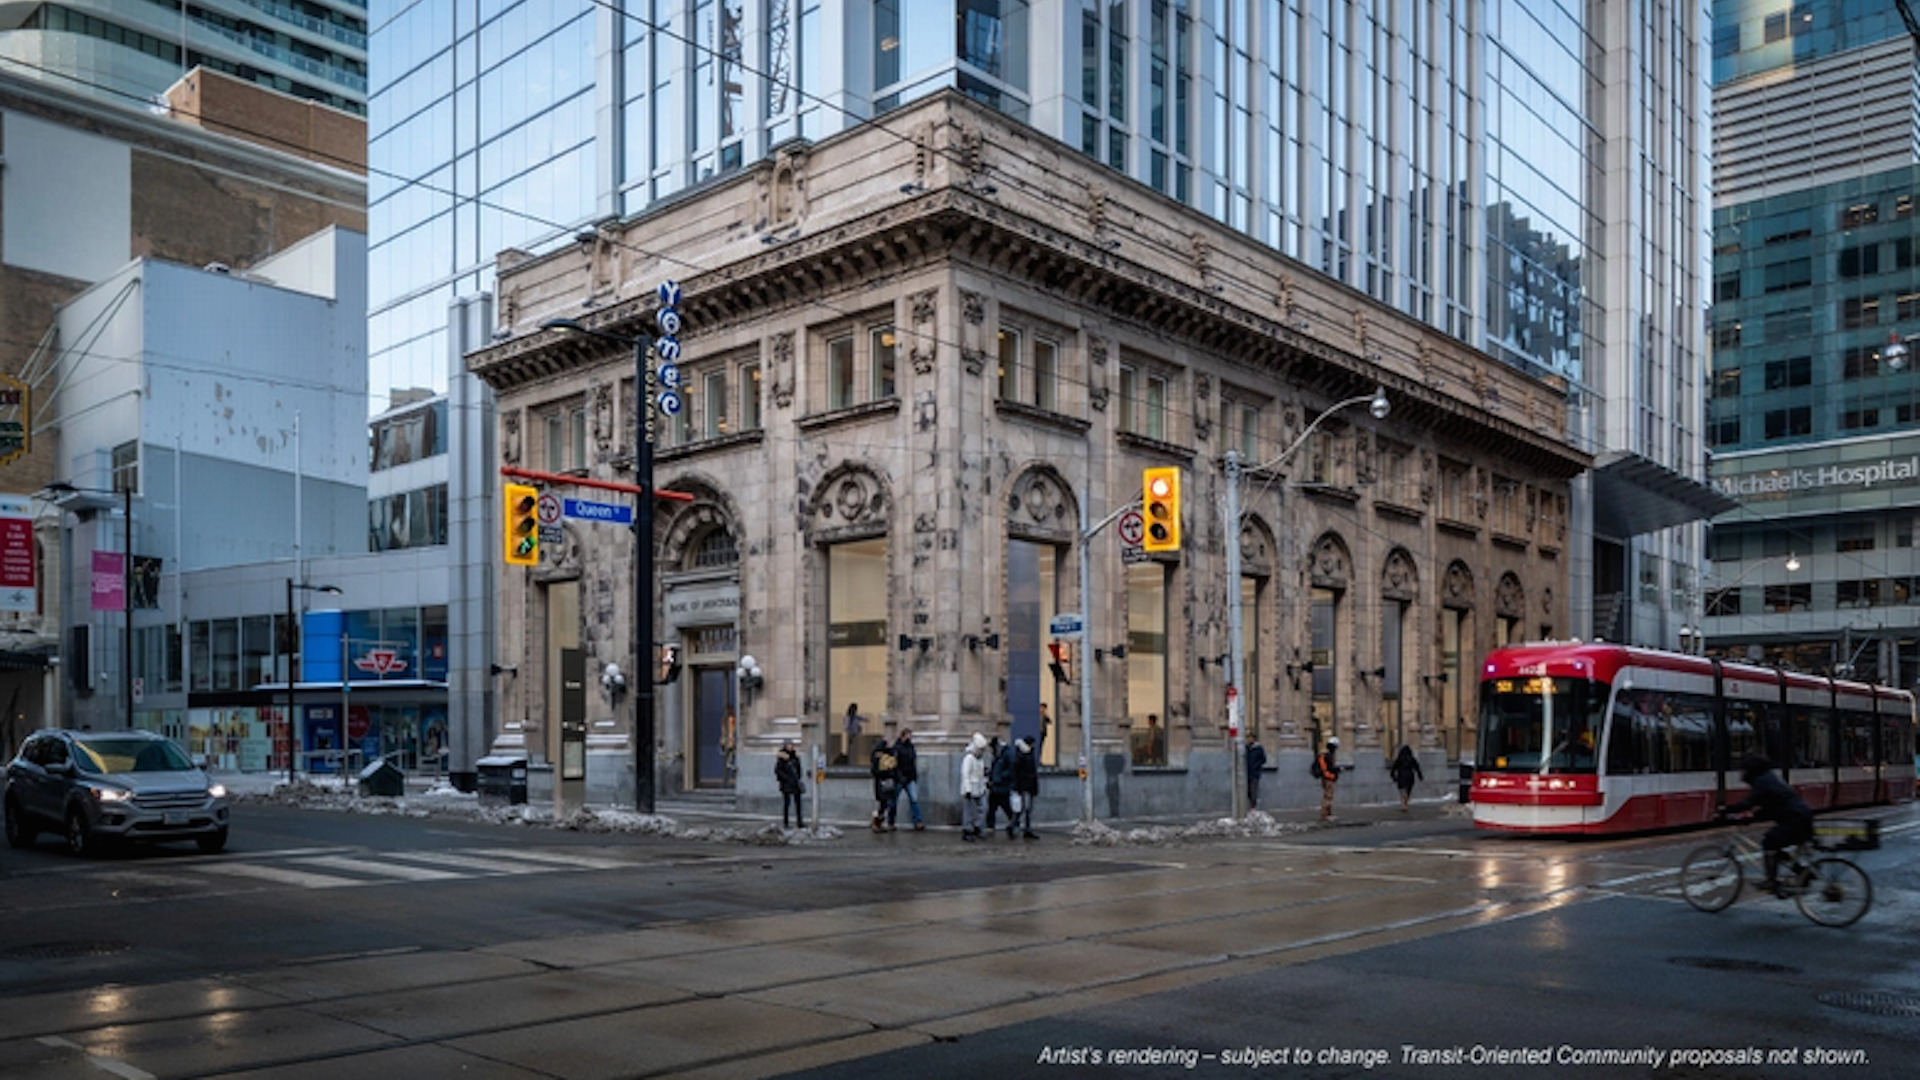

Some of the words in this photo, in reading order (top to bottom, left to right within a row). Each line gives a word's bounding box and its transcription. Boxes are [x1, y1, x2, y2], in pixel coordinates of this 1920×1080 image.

[658, 280, 681, 416] Yonge
[1718, 469, 1813, 494] Michael's
[1818, 456, 1919, 487] Hospital
[576, 500, 612, 519] Queen
